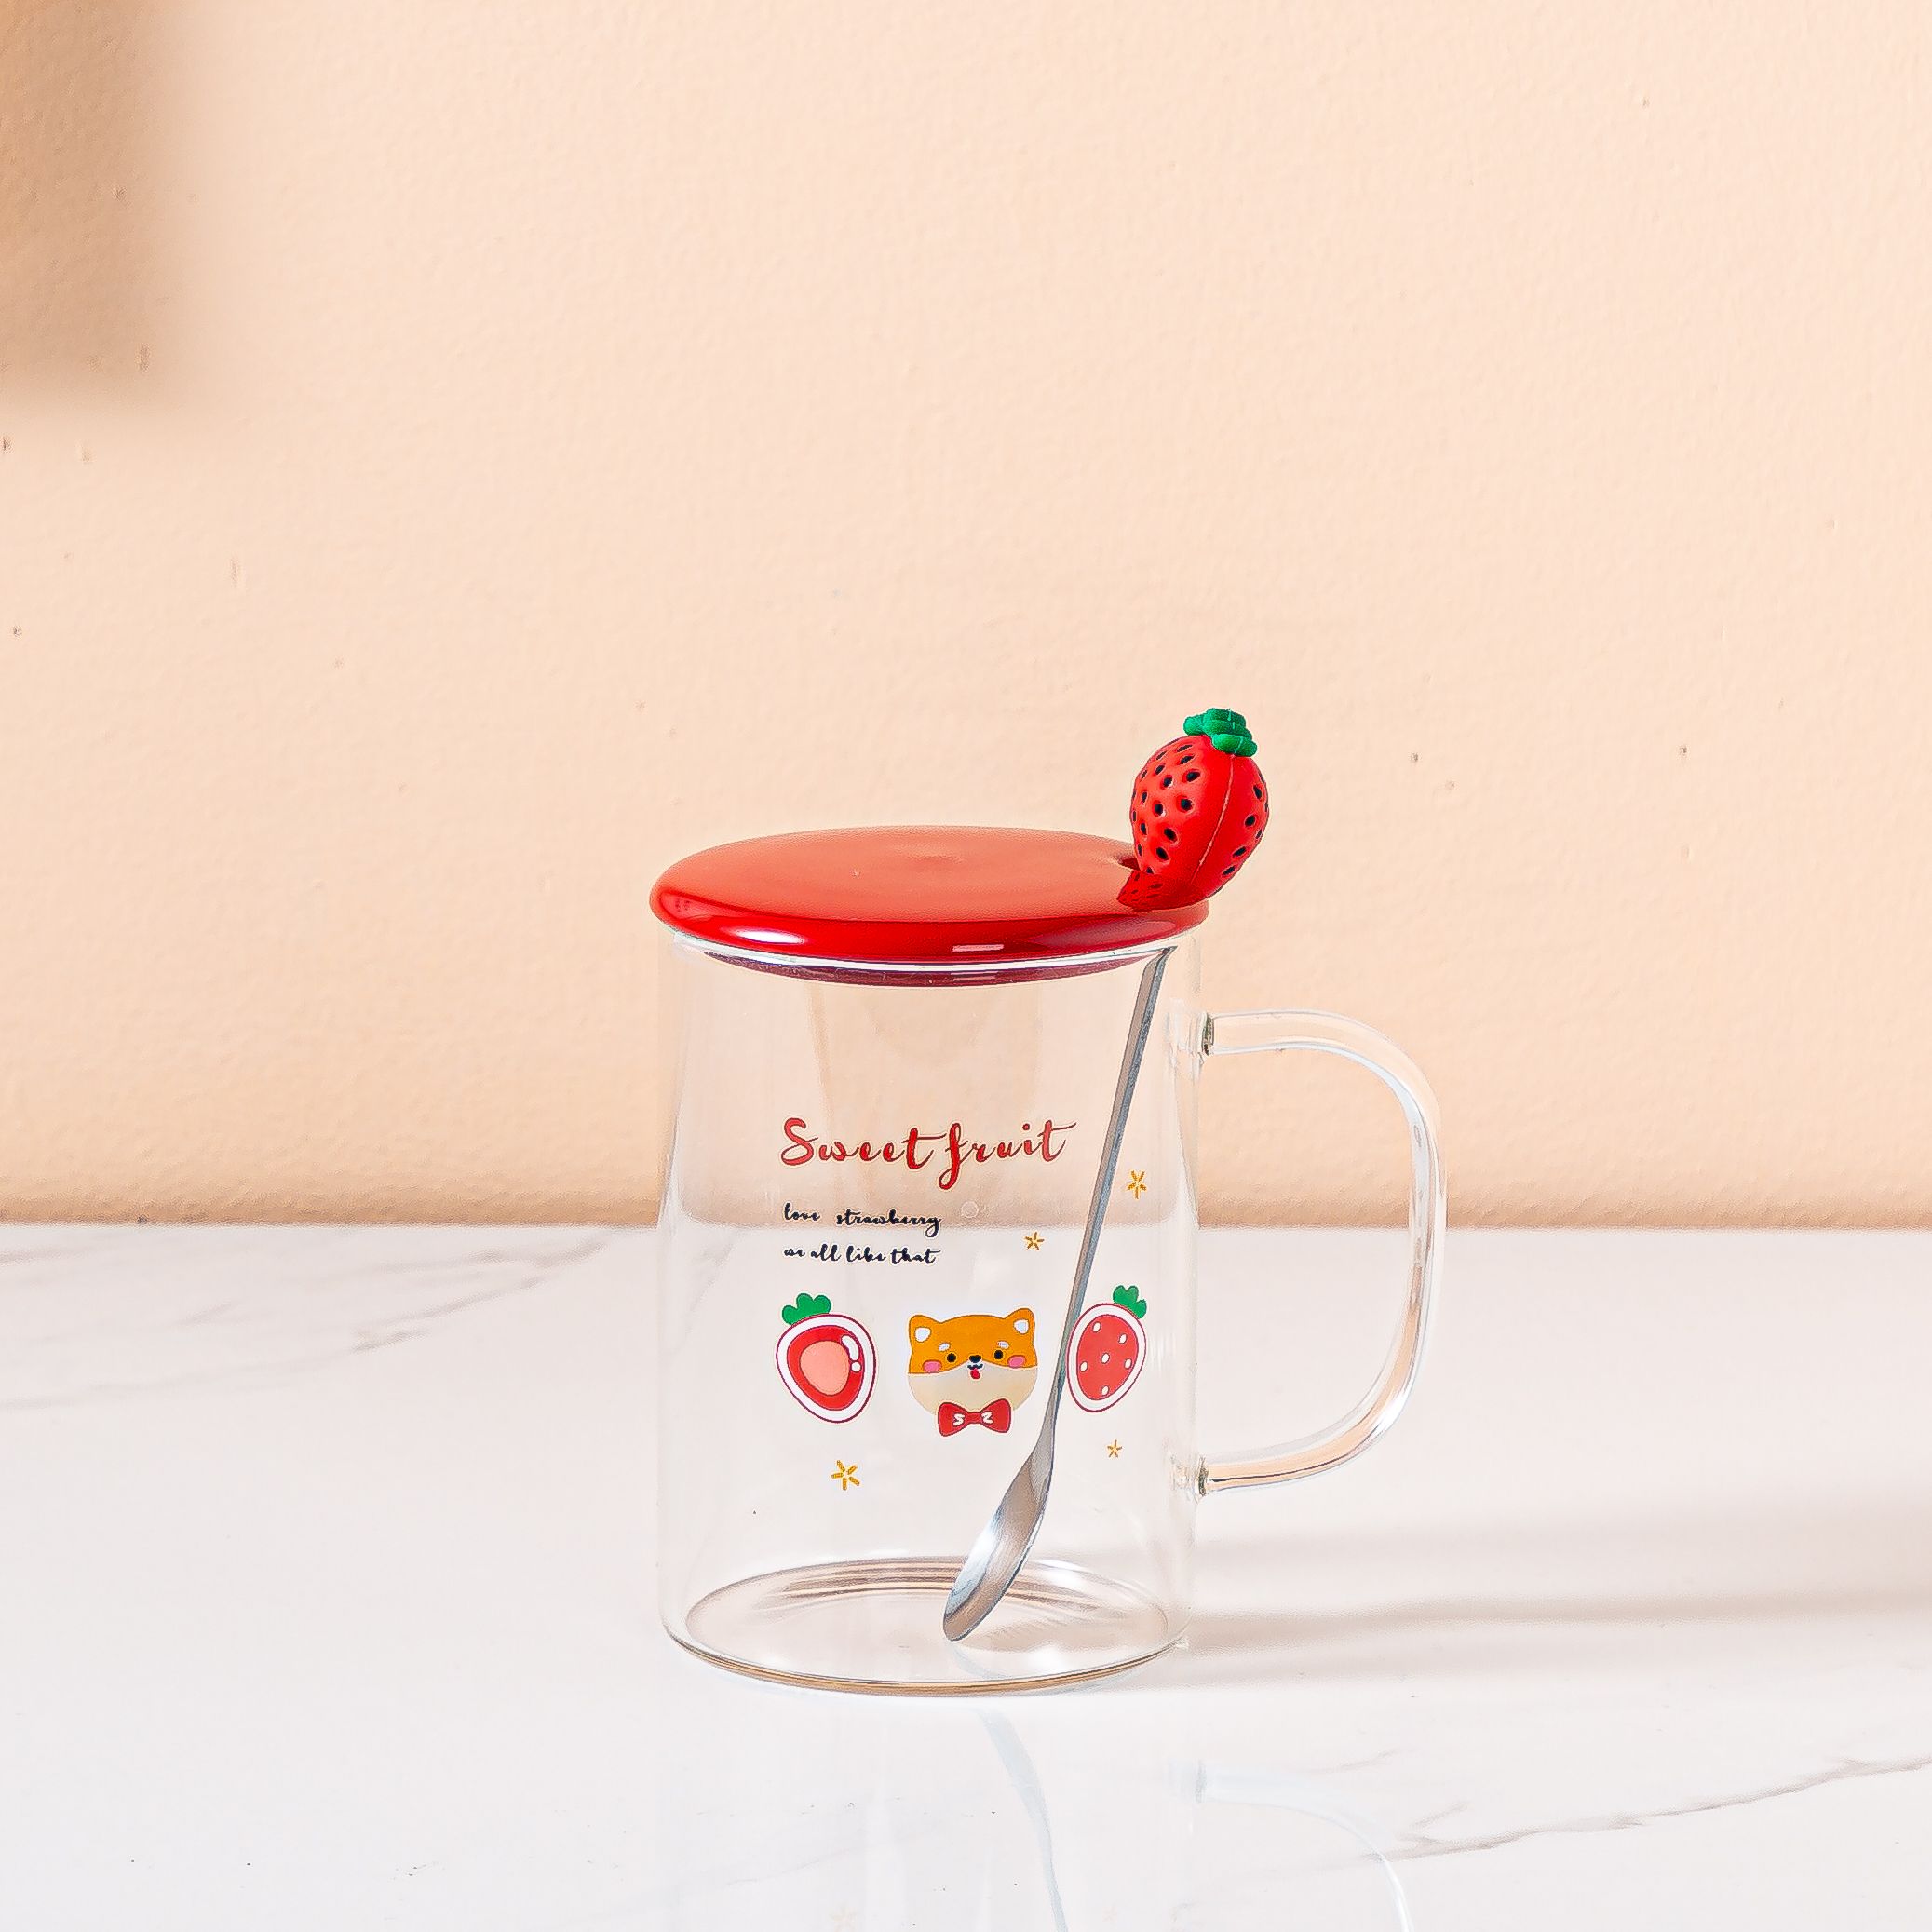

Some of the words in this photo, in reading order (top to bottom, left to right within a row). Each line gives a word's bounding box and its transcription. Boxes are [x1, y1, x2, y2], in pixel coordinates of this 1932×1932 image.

[781, 1117, 947, 1169] Sweet
[939, 1120, 1077, 1190] fruit
[783, 1202, 821, 1222] love
[836, 1209, 941, 1237] strawberry
[783, 1247, 806, 1258] we
[810, 1243, 842, 1262] all
[845, 1245, 886, 1263] like
[890, 1247, 940, 1264] that
